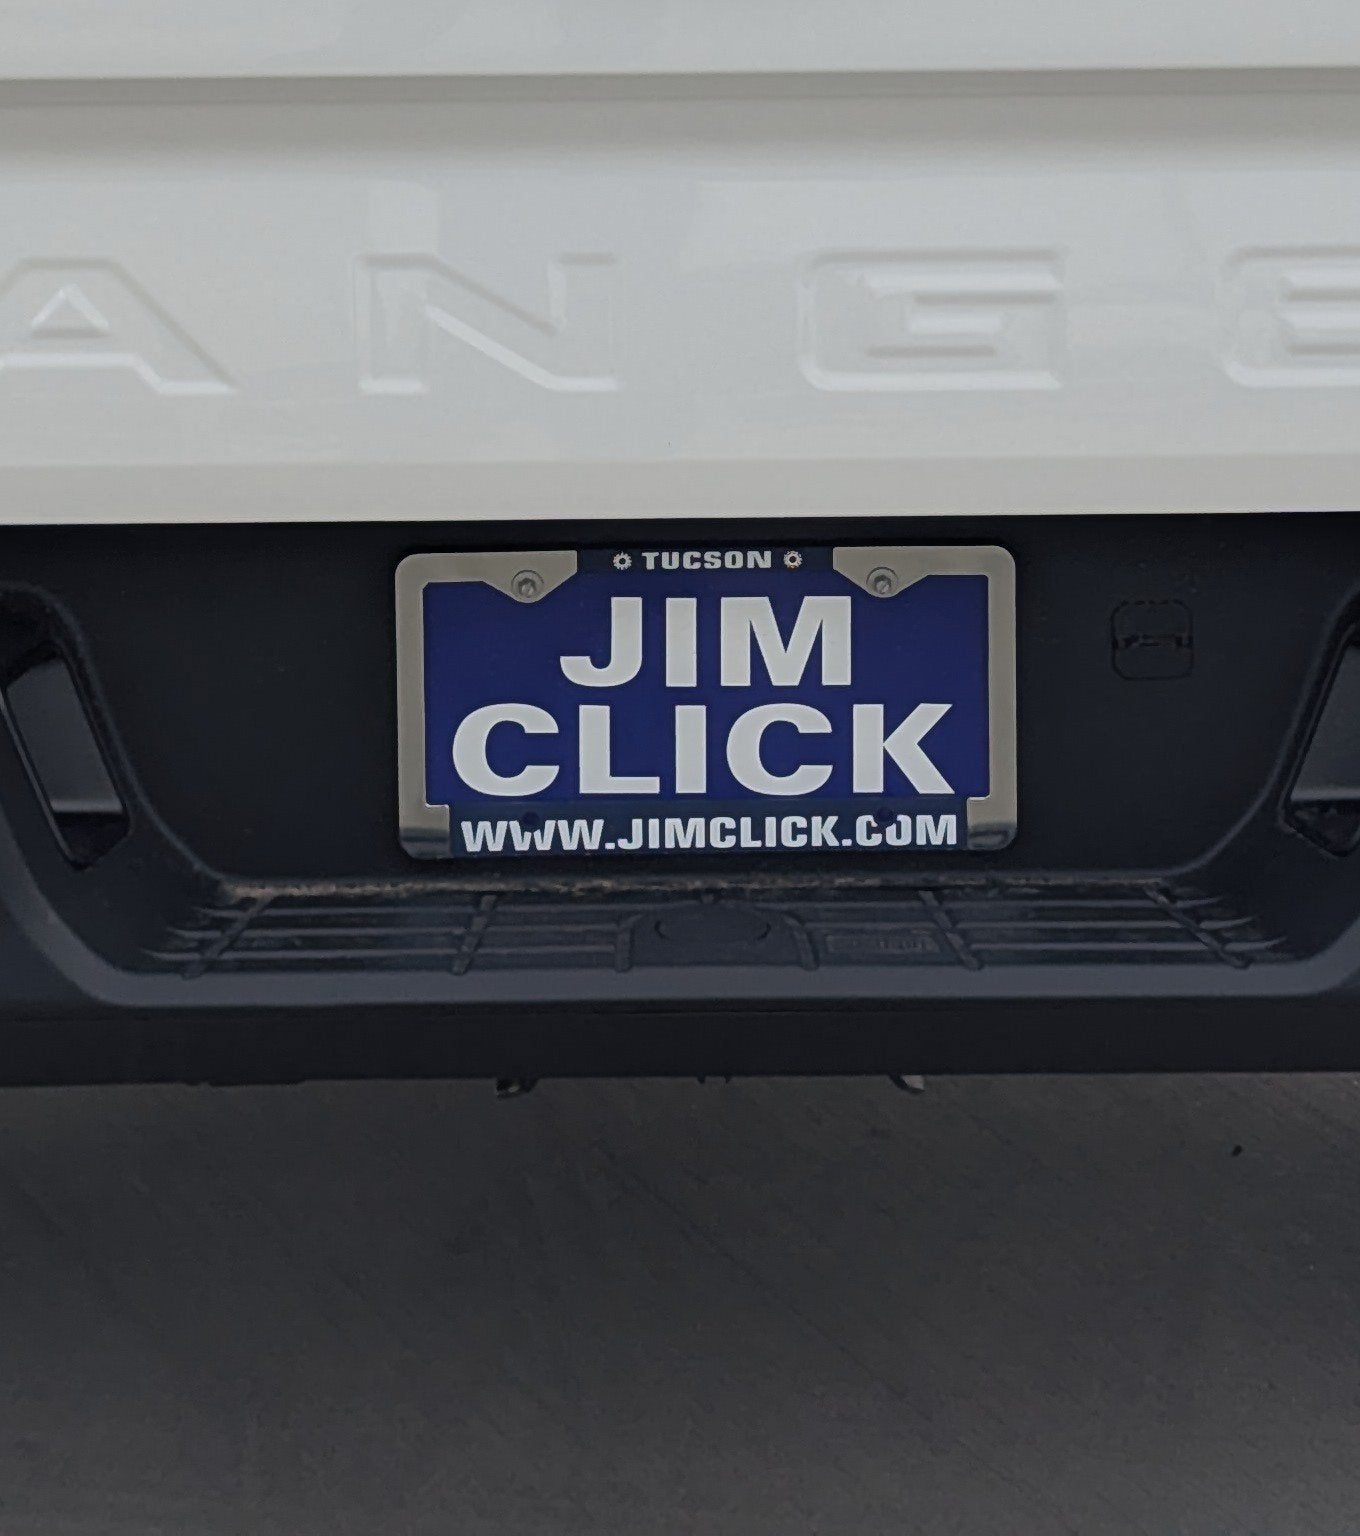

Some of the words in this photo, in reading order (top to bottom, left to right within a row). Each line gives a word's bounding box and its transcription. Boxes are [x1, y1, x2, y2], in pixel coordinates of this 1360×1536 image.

[641, 550, 773, 571] TUCSON
[559, 595, 852, 688] JIM
[452, 703, 956, 796] CLICK
[460, 814, 958, 853] WWW.JIMCLICK.COM
